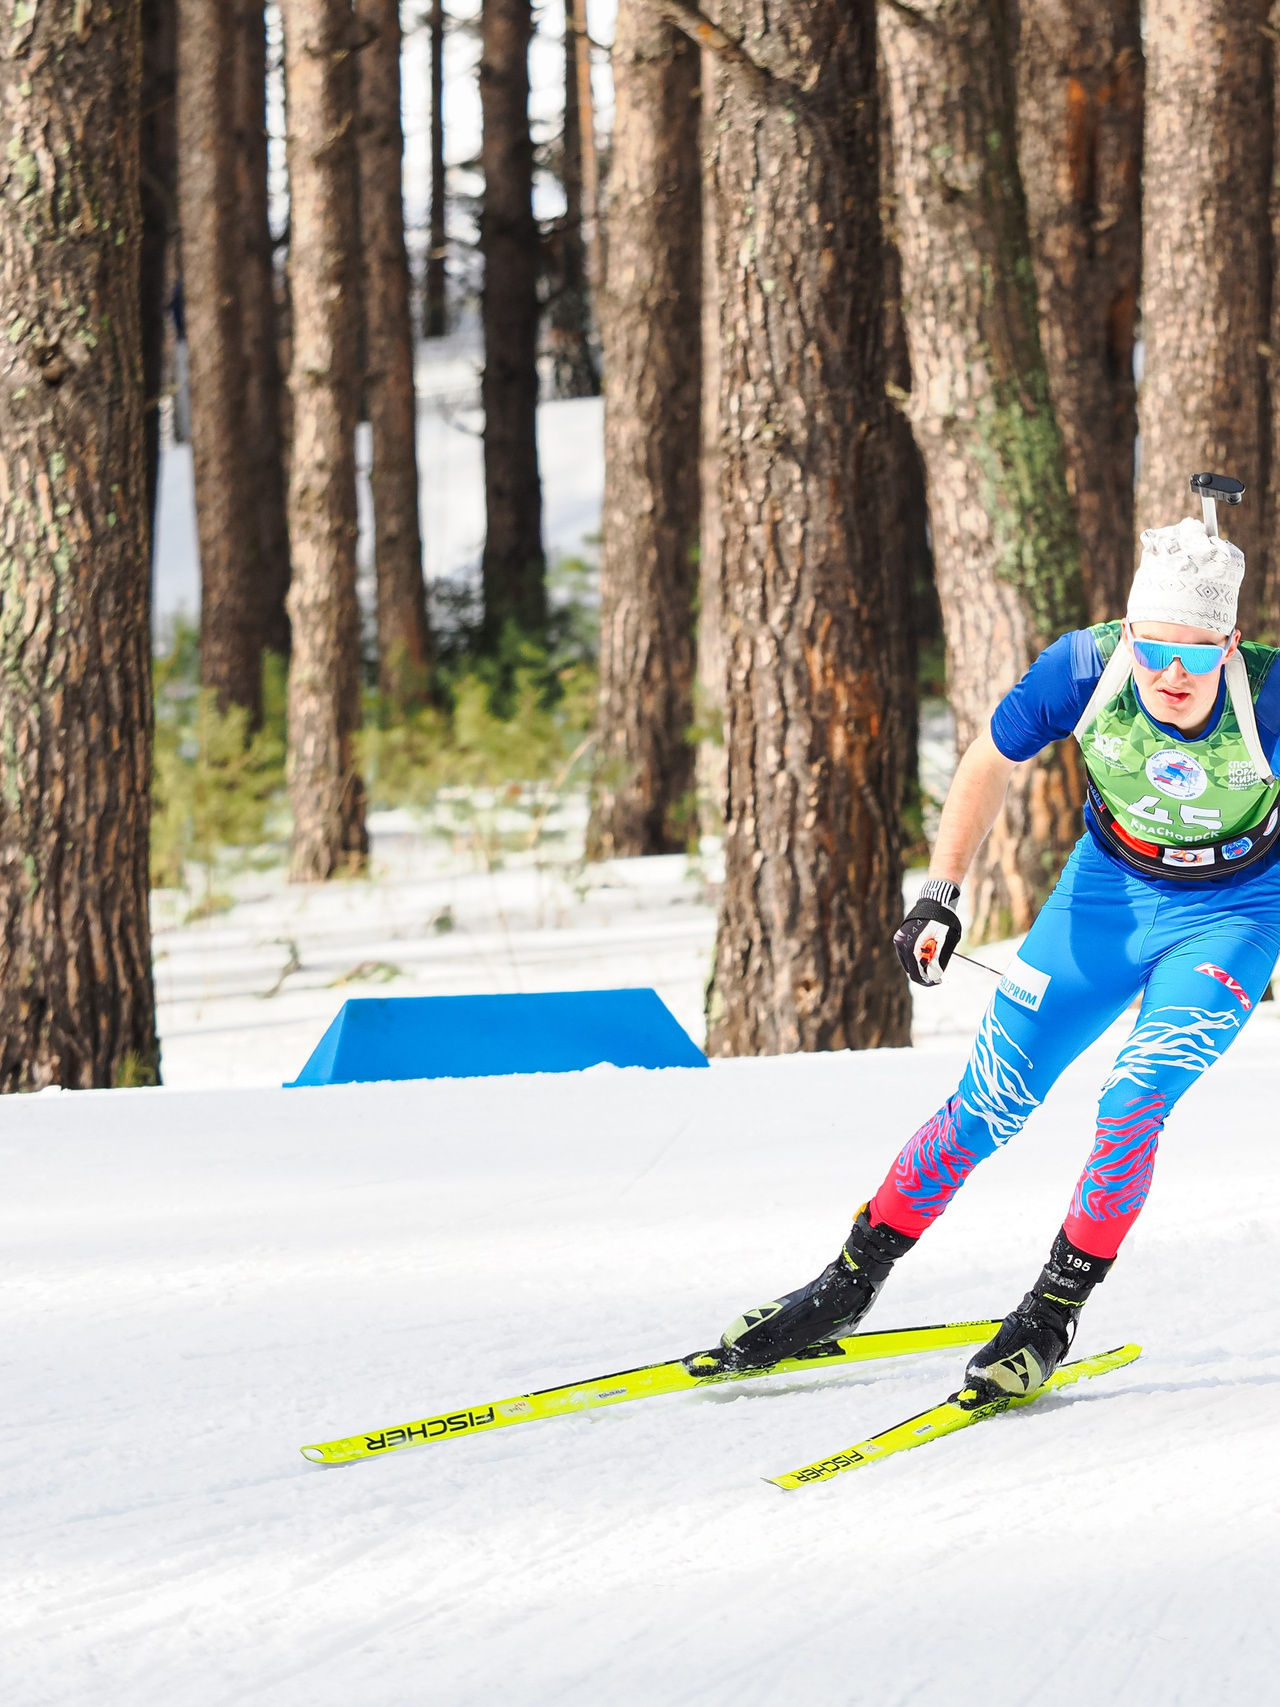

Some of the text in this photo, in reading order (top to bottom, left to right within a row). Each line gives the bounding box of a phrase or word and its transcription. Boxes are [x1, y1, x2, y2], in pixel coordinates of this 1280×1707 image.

[1228, 760, 1255, 768] СПОР
[1228, 768, 1257, 776] НОРМ
[1126, 795, 1223, 830] 45
[1066, 1254, 1092, 1272] 195
[364, 1406, 495, 1450] FISCHER
[790, 1450, 864, 1482] FISCHER
